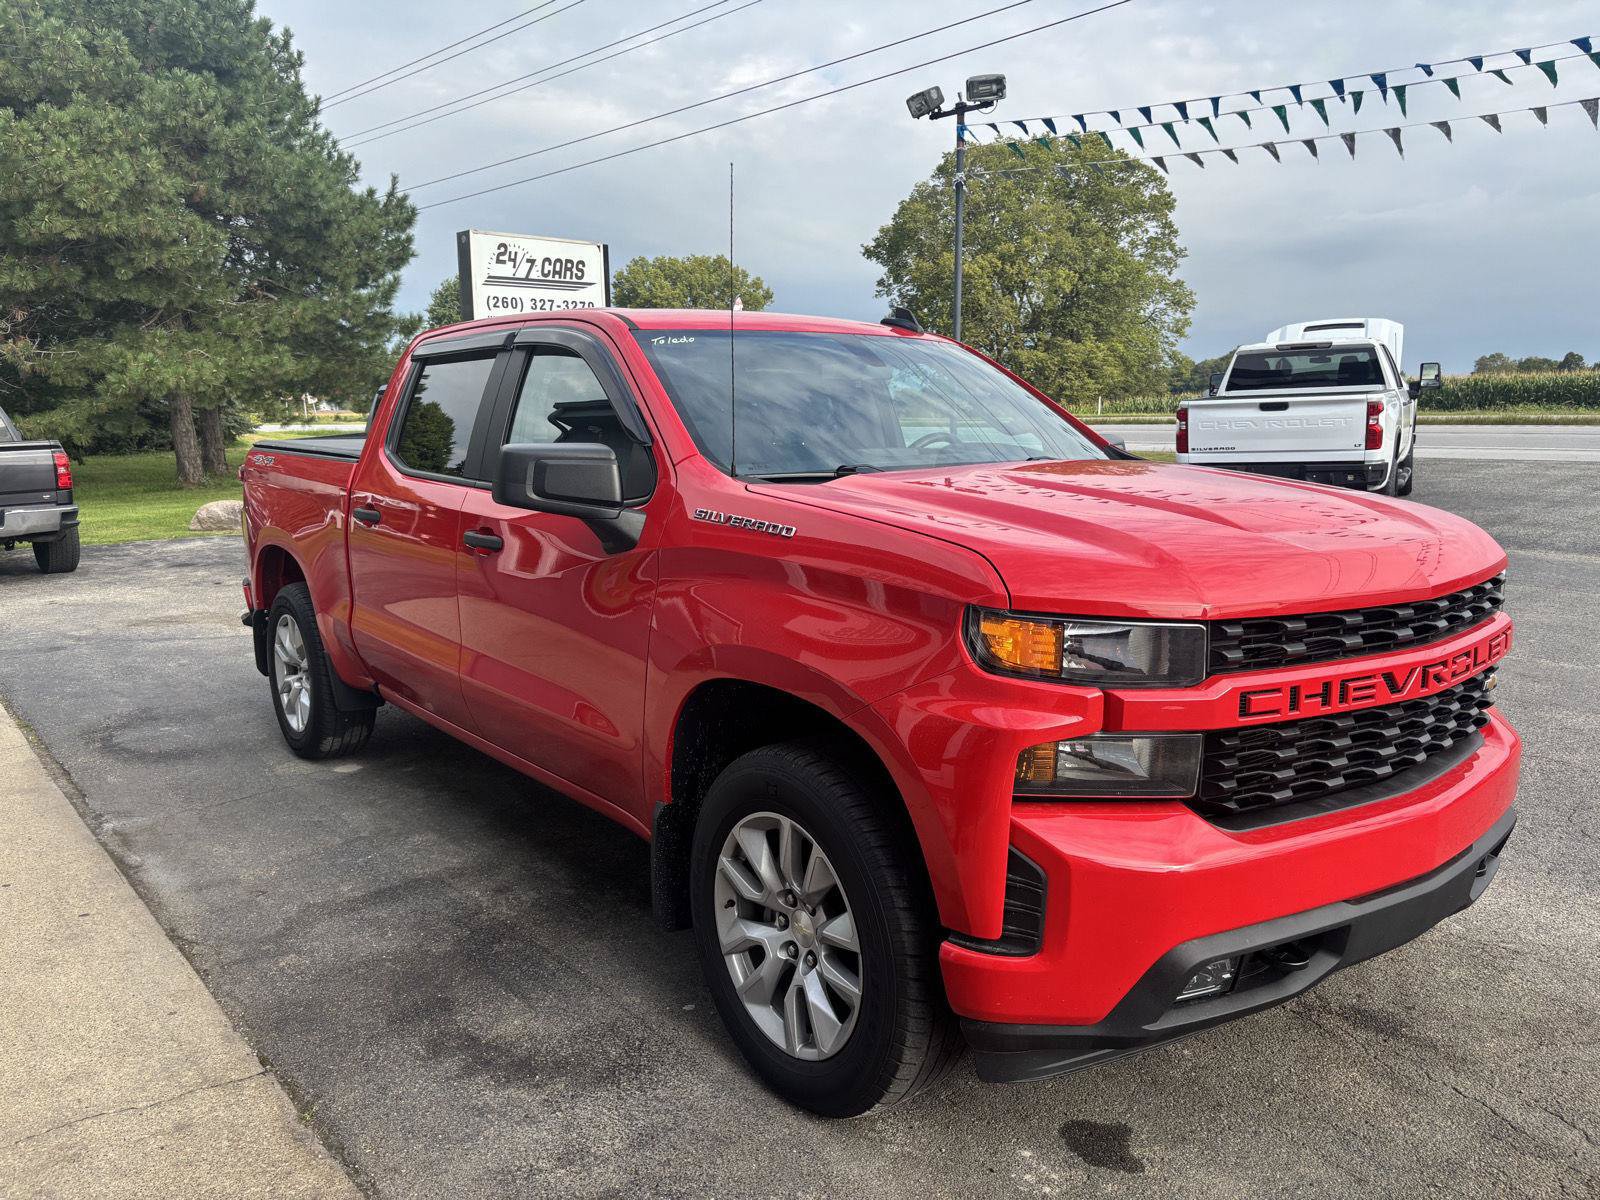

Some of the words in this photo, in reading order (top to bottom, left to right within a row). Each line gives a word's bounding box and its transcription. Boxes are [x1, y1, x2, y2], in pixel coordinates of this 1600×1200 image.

[495, 242, 536, 280] 24/7
[541, 257, 586, 281] CARS
[486, 295, 524, 313] (260)
[1198, 416, 1353, 431] CHEVROLET
[694, 508, 796, 535] SILVERADO
[1237, 622, 1512, 722] CHEVROLET
